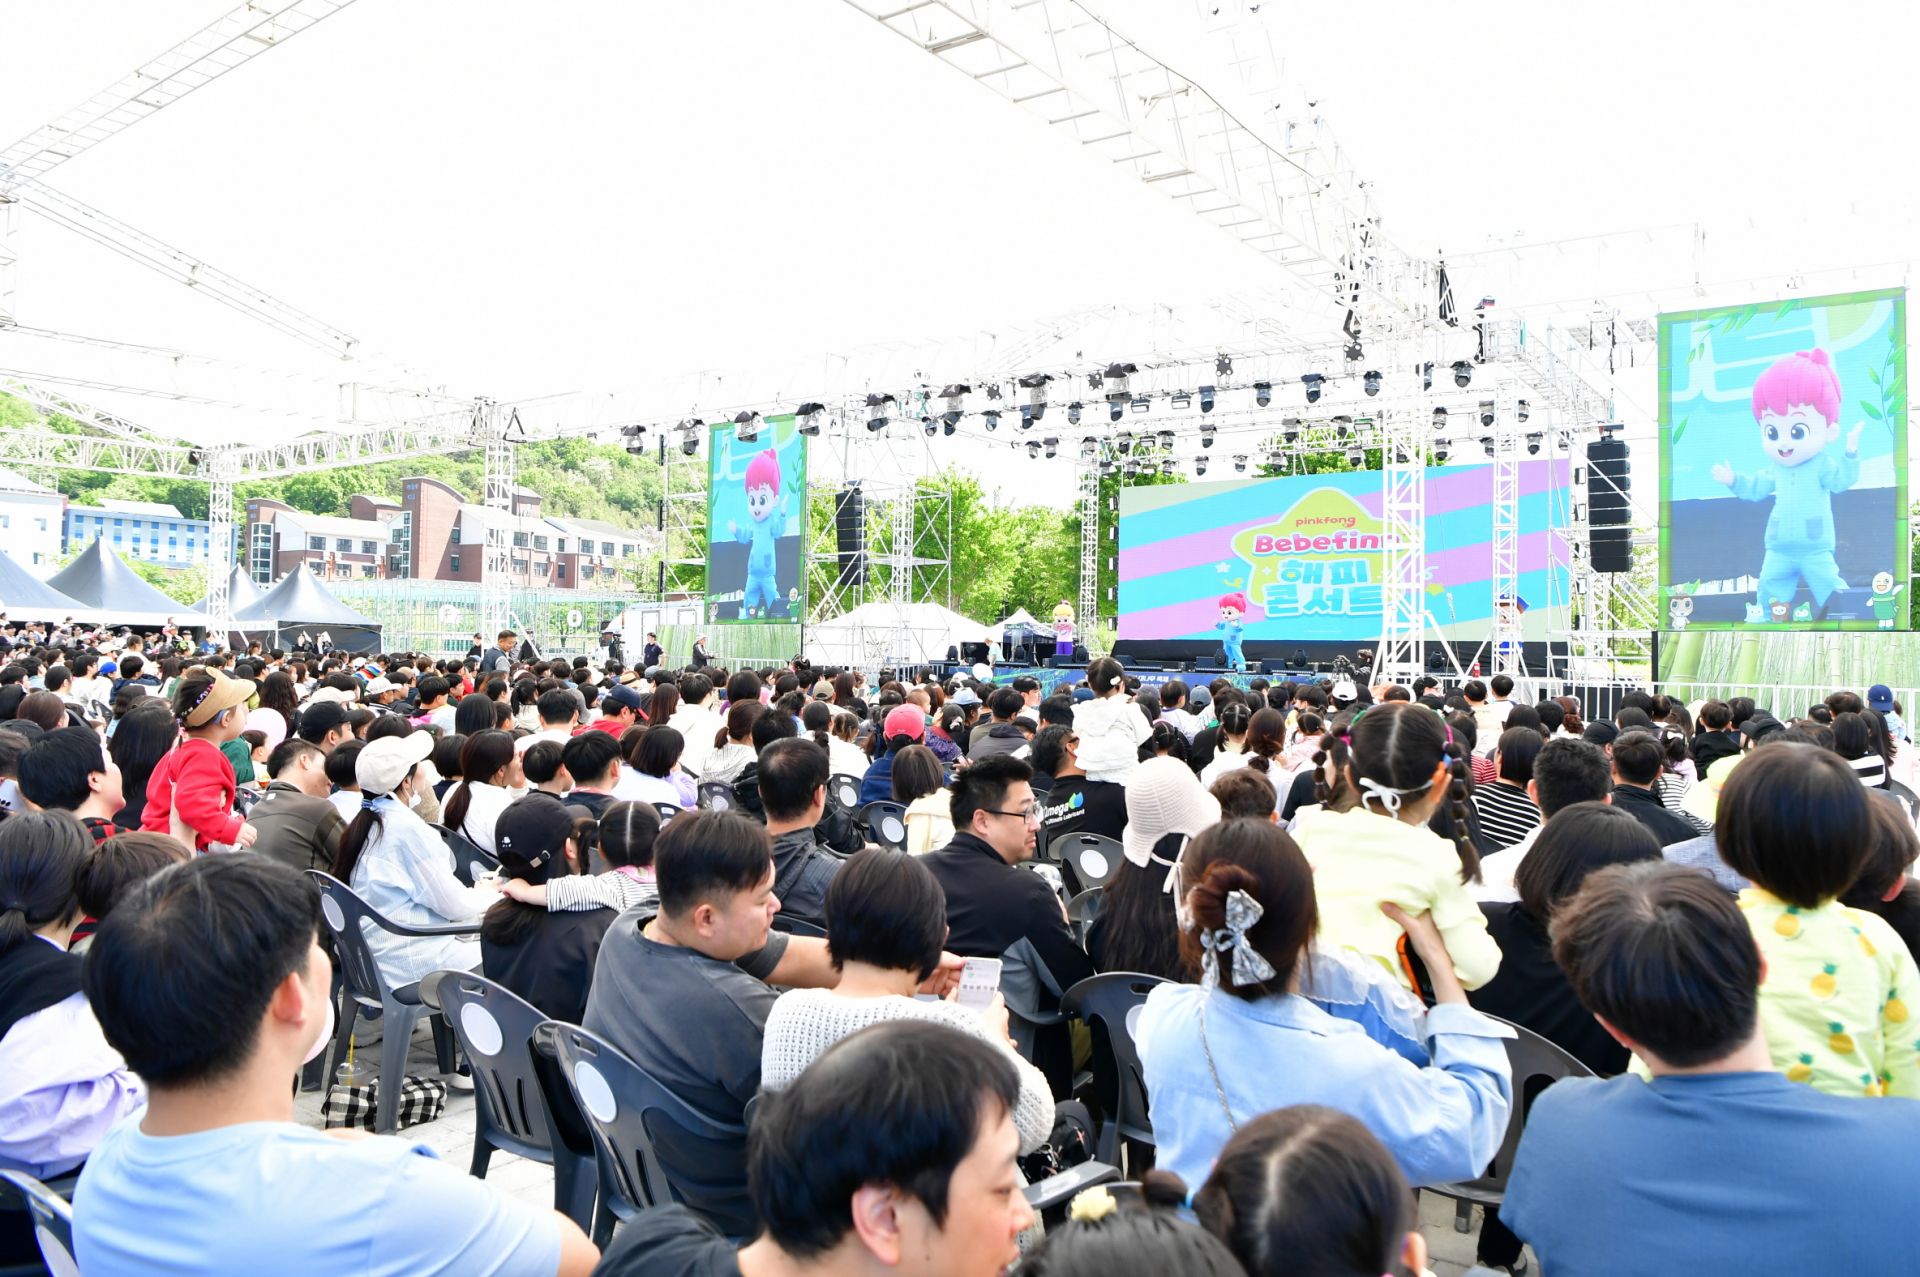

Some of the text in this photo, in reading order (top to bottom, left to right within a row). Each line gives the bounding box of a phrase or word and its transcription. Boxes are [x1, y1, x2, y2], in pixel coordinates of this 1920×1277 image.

[1295, 516, 1356, 528] pinkfong
[1280, 560, 1369, 585] 해피
[1265, 585, 1384, 615] 콘서트
